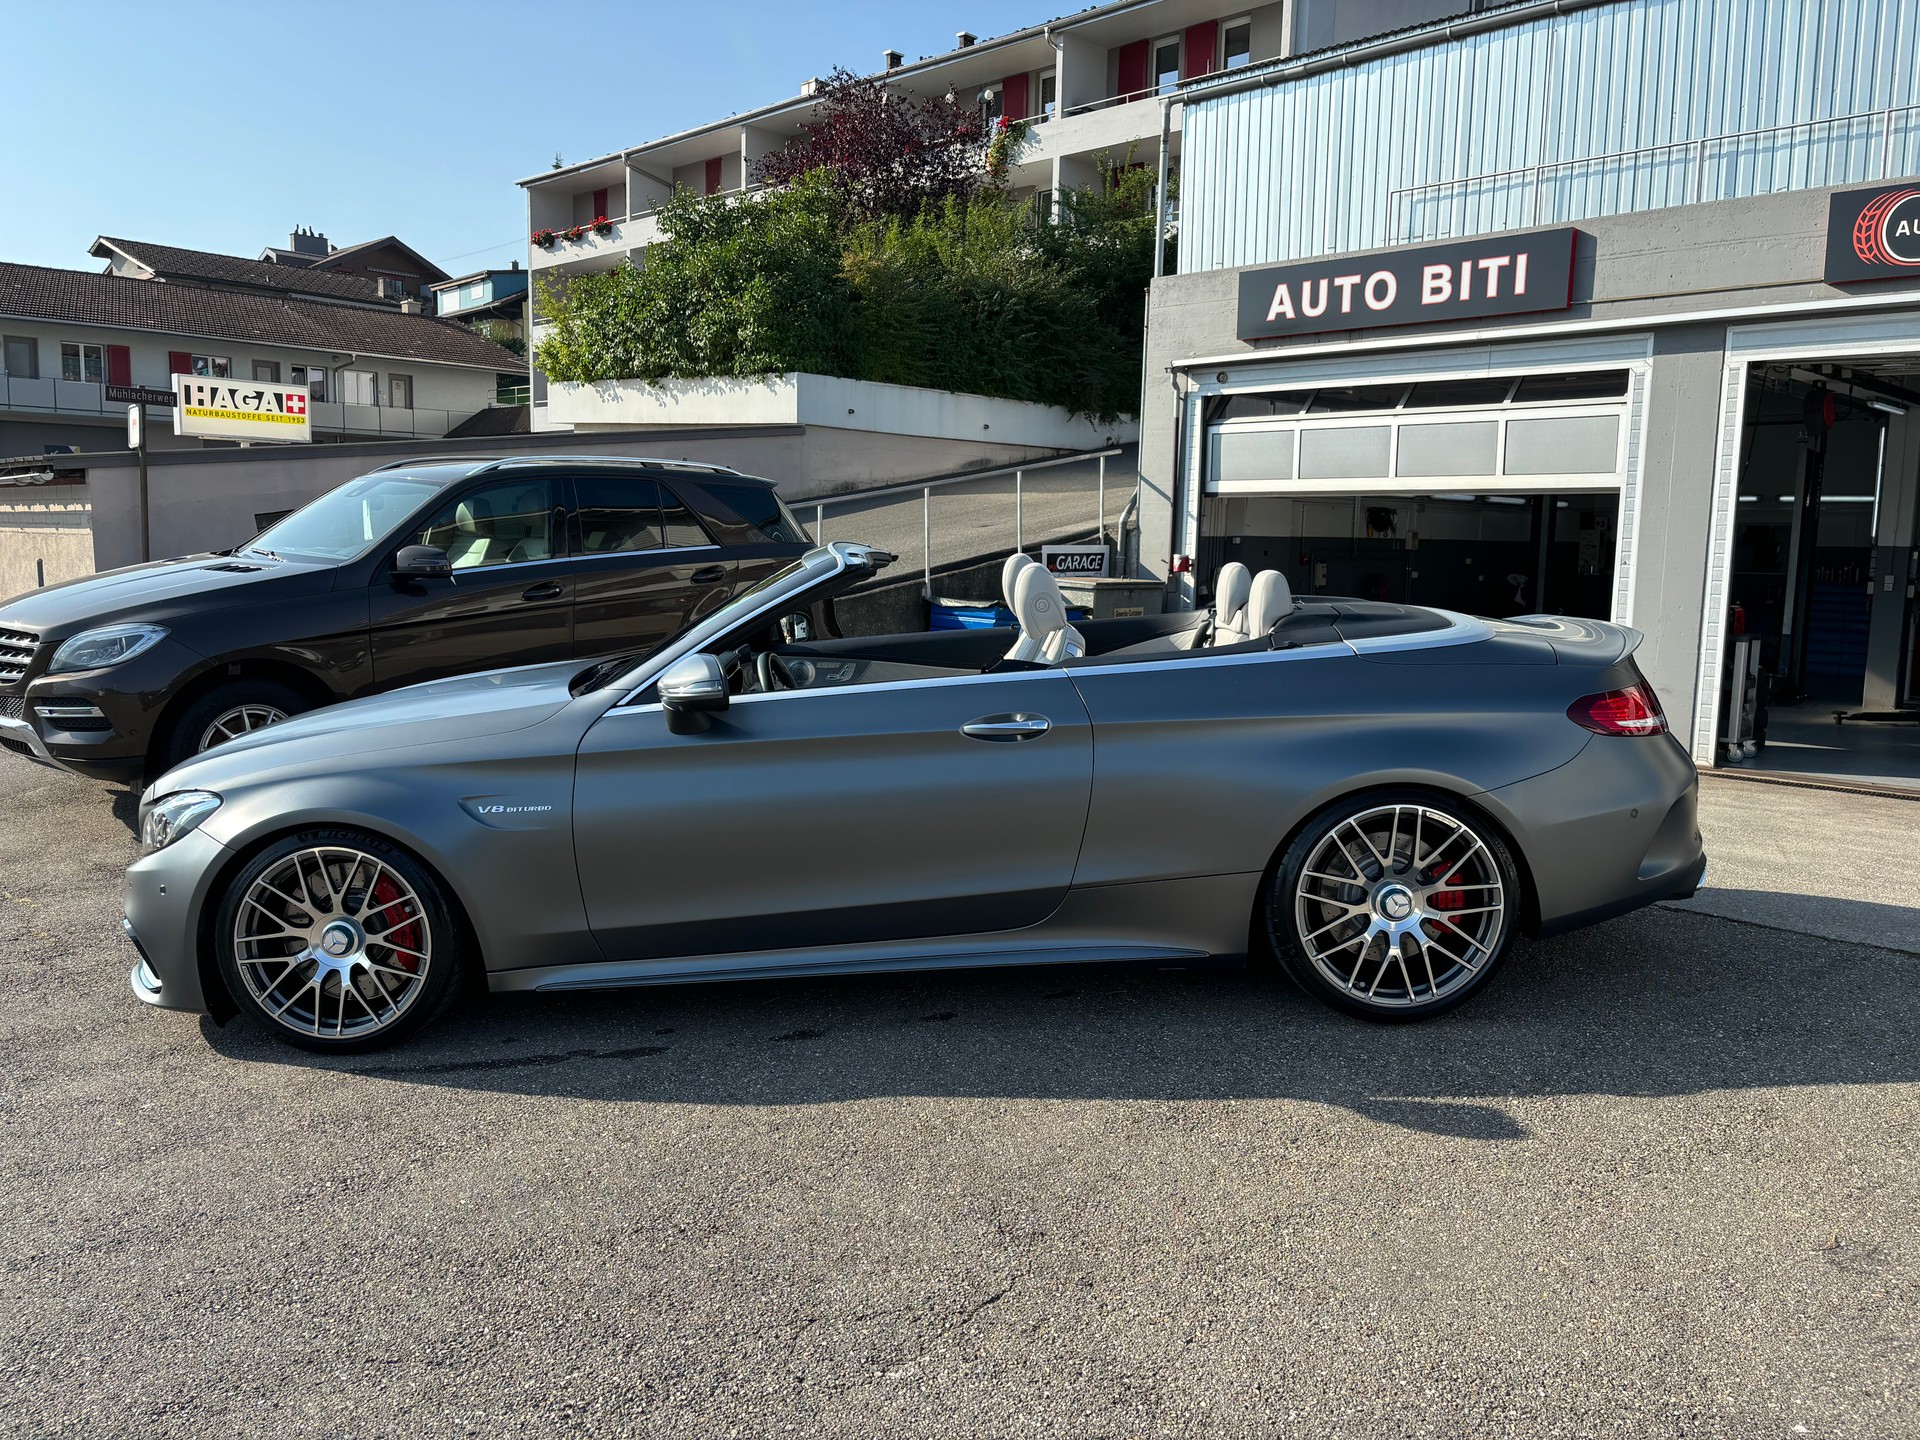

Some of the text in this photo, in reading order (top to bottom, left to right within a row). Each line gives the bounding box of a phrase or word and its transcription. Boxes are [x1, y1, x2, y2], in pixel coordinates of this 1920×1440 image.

[1266, 253, 1529, 322] AUTO BITI
[108, 386, 175, 406] Mühlacherweg
[184, 384, 284, 413] HAGA
[186, 408, 262, 421] NATURBAUSTOFFE
[287, 416, 306, 424] 1953
[1056, 555, 1102, 570] GARAGE
[478, 805, 504, 814] V8
[317, 829, 390, 852] MICHELIN
